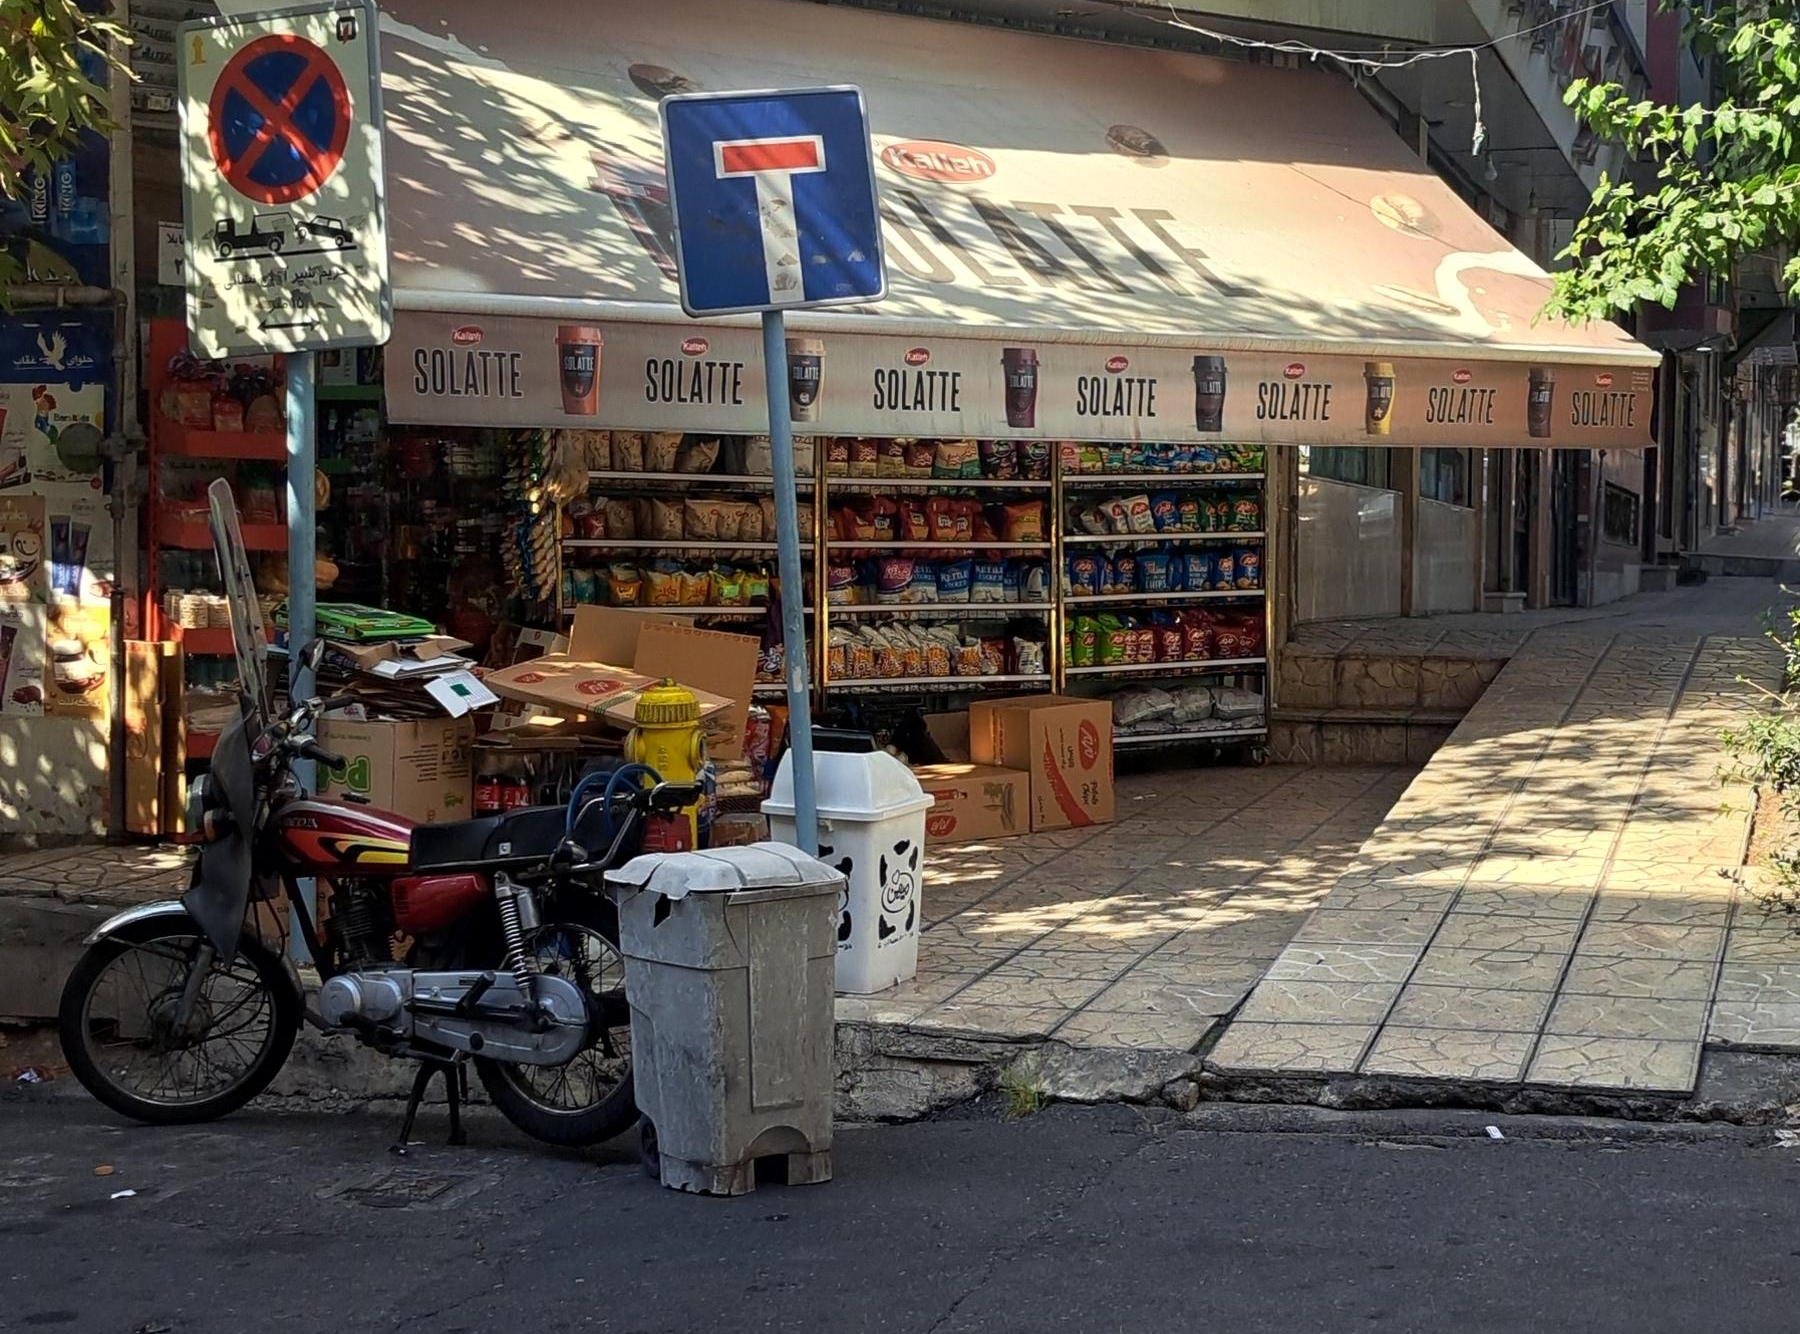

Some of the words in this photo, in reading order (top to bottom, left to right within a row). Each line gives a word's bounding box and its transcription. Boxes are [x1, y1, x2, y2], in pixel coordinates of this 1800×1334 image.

[881, 189, 1266, 297] OLATTE
[414, 348, 524, 397] SOLATTE
[645, 358, 744, 405] SOLATTE
[873, 368, 961, 412] SOLATTE
[1077, 376, 1157, 417] SOLATTE
[1256, 382, 1332, 420] SOLATTE
[1426, 387, 1496, 424] SOLATTE
[1571, 391, 1636, 427] SOLATTE
